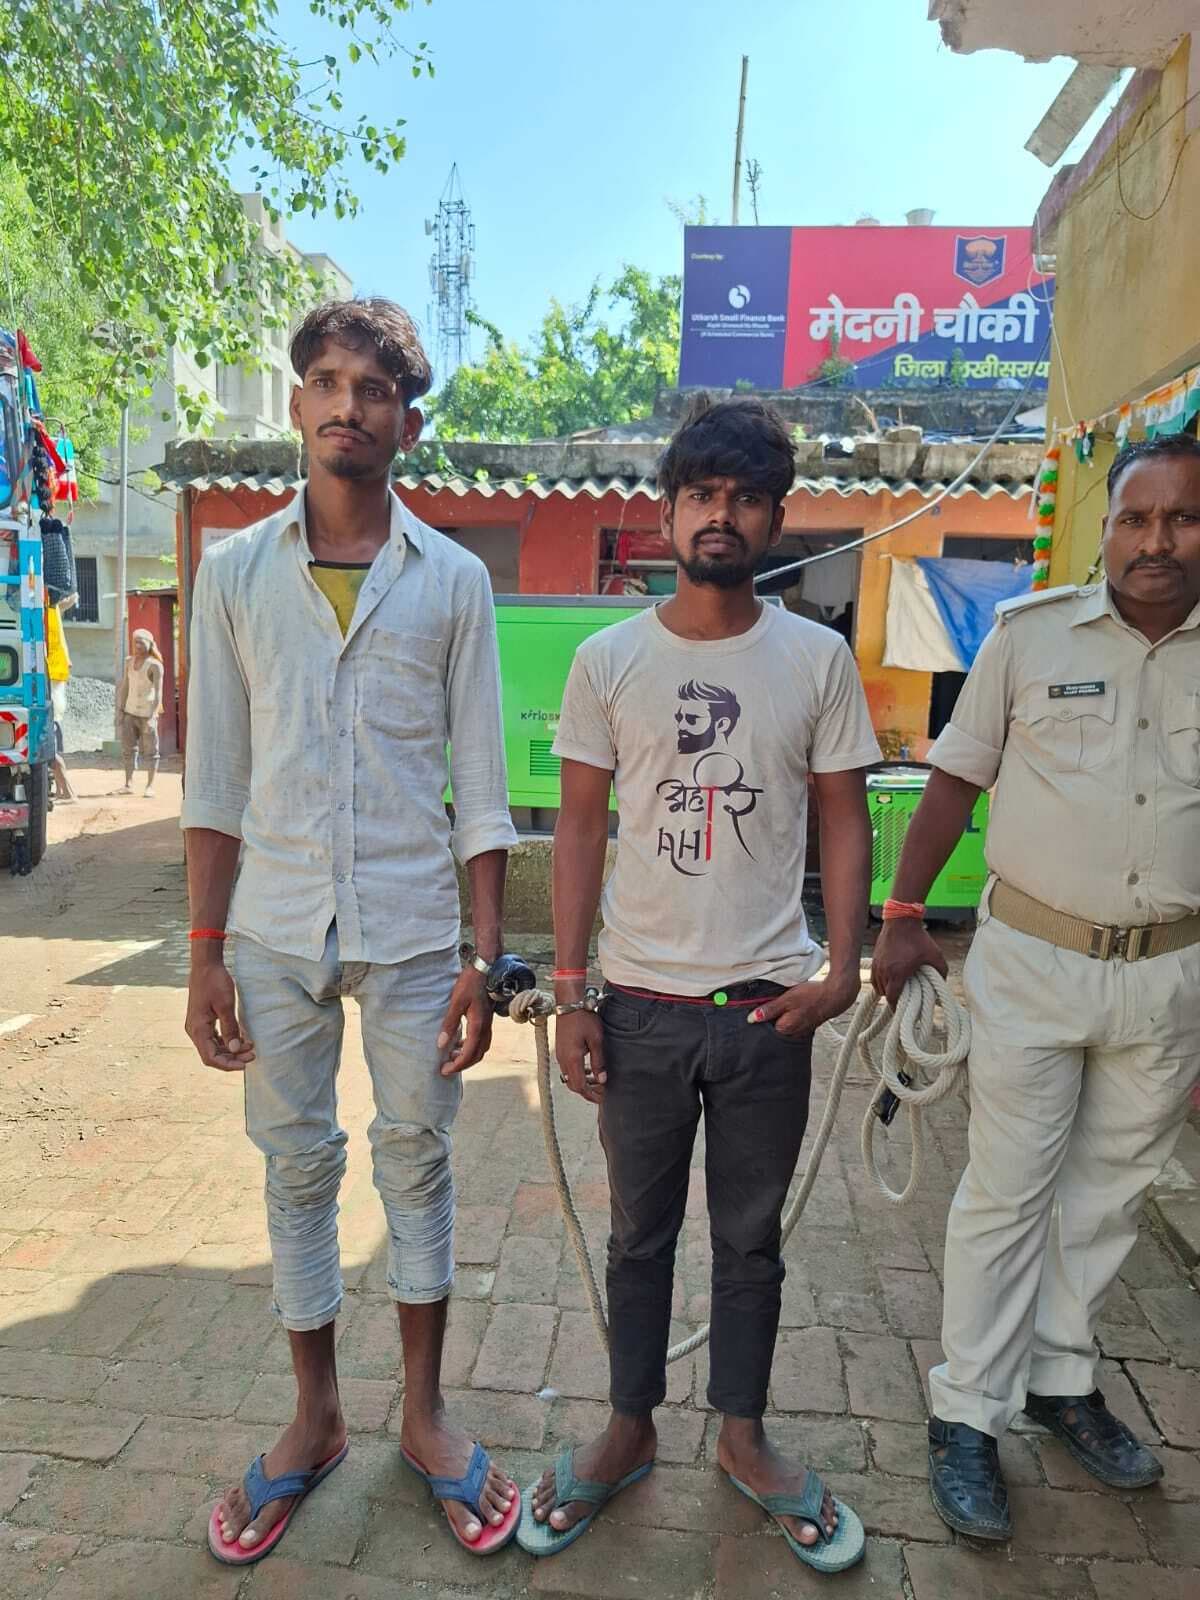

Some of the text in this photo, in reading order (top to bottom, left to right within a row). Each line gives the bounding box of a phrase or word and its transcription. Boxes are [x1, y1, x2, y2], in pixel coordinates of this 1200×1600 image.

[809, 292, 1039, 343] मेदनी चौकी
[894, 353, 948, 378] जिला
